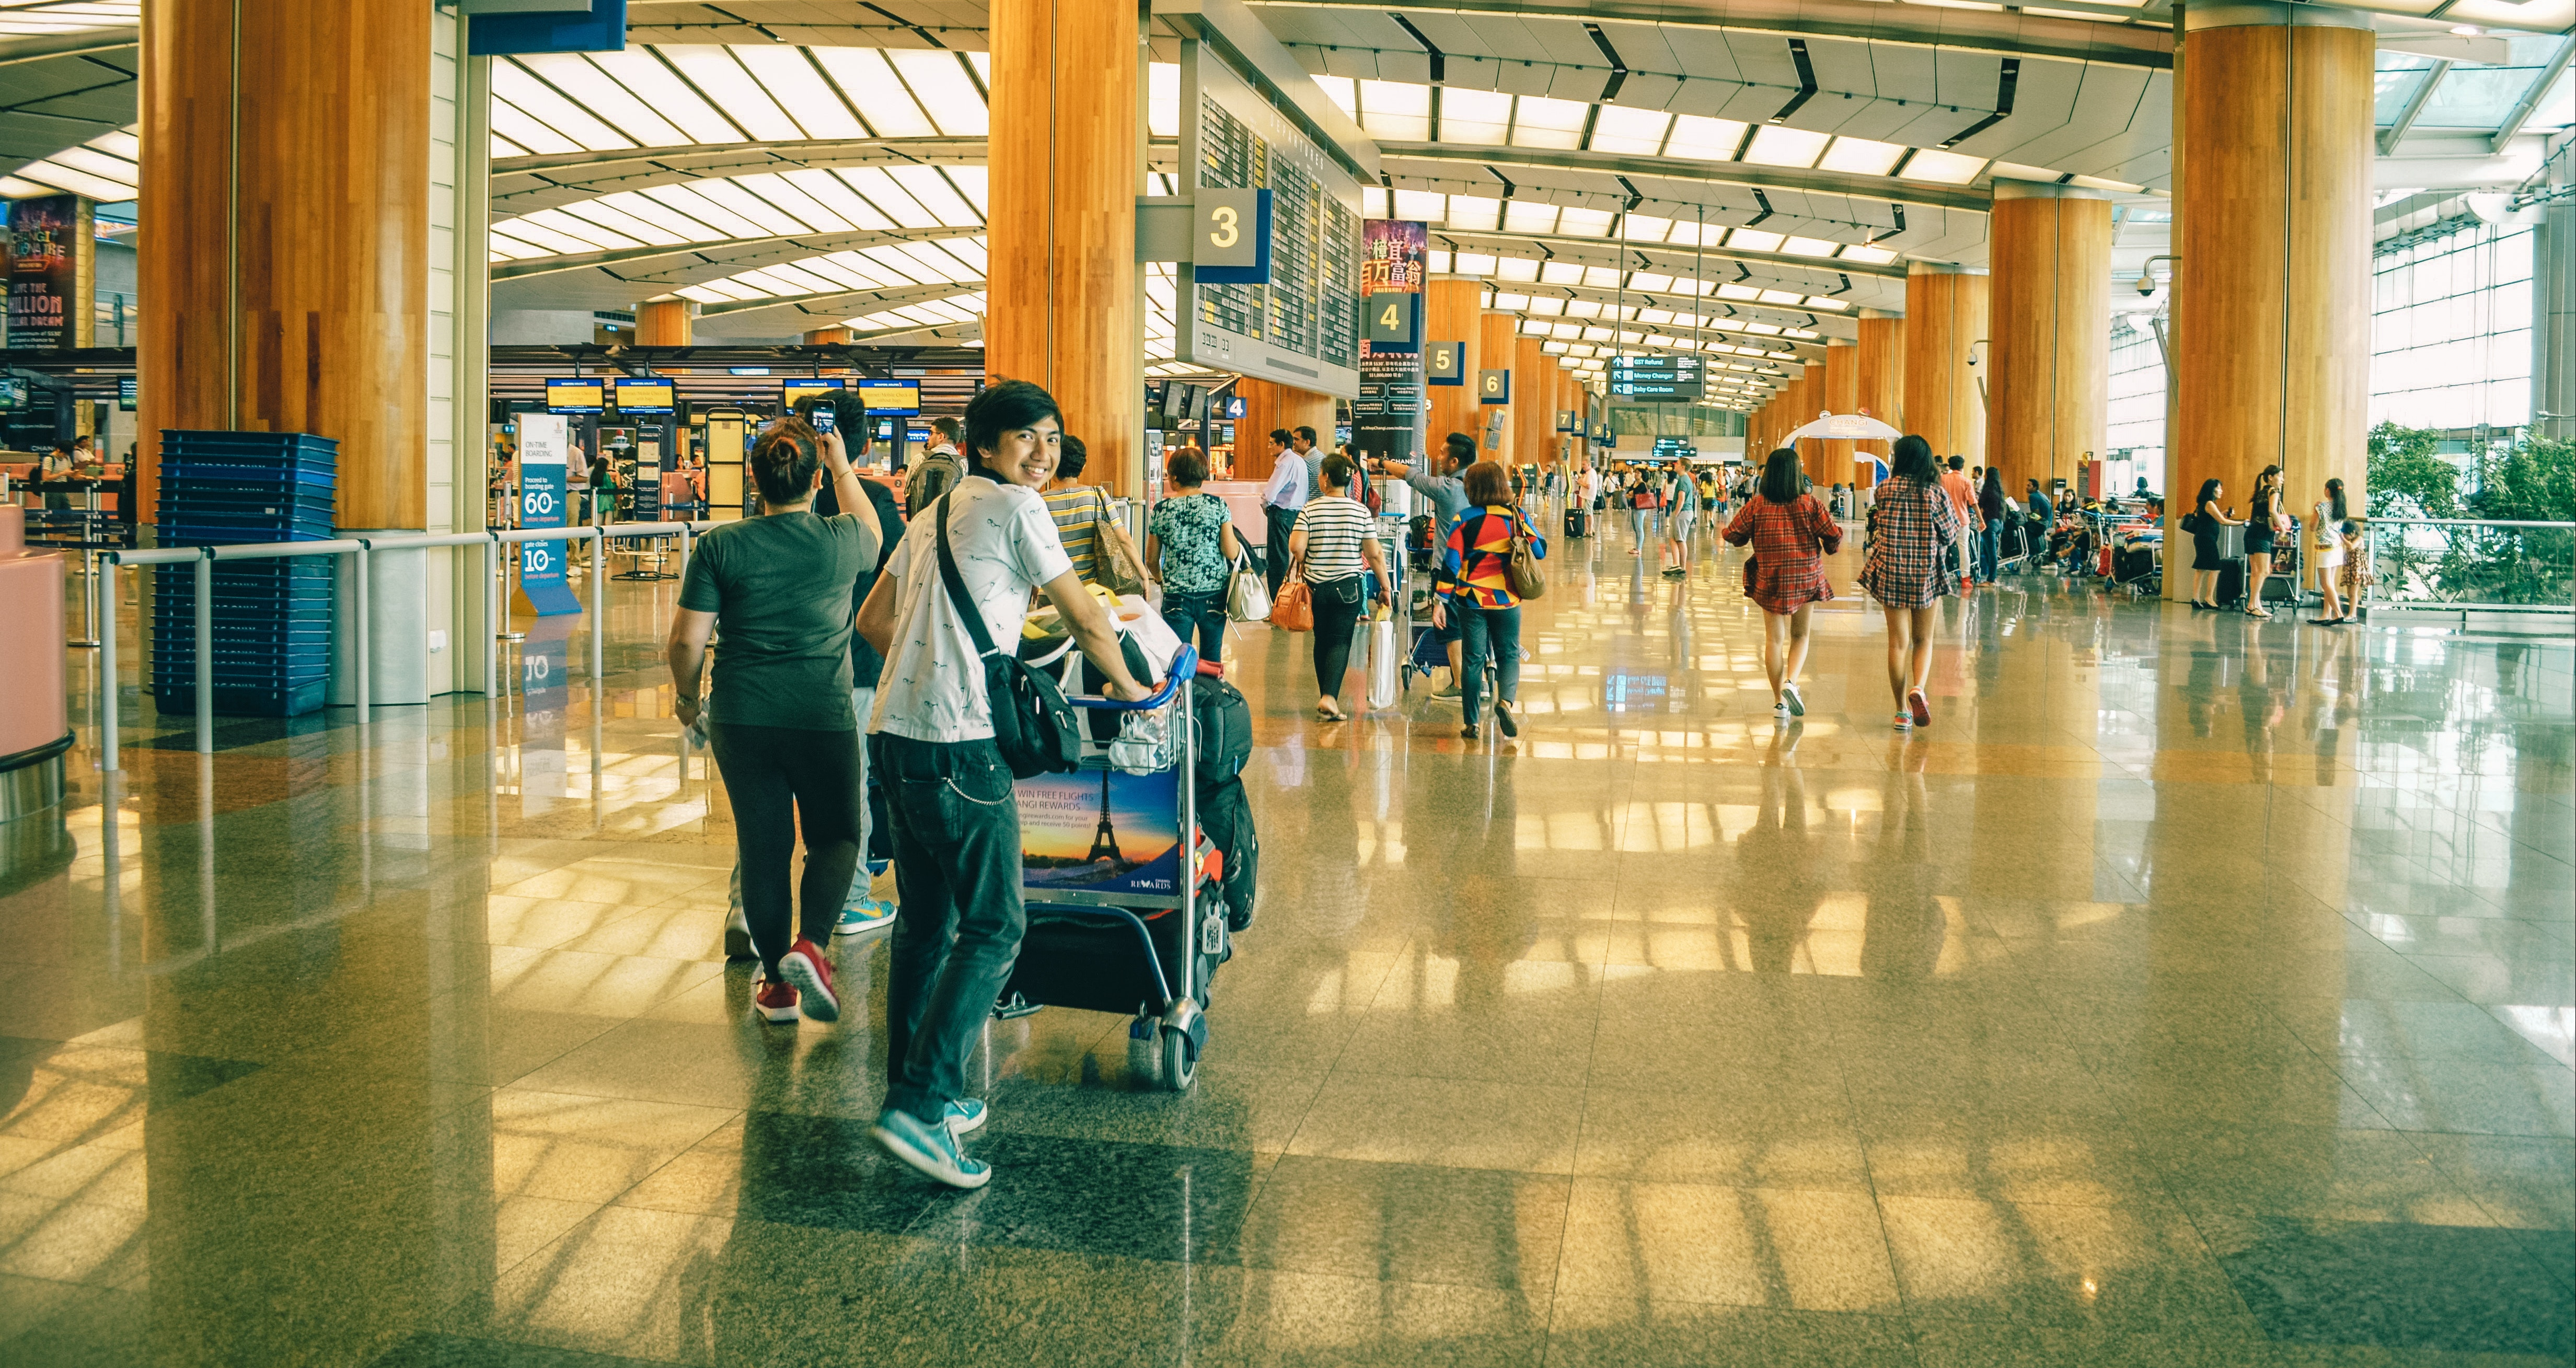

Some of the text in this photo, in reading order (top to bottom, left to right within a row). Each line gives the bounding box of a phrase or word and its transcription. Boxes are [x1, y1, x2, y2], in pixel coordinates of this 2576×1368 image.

[1270, 113, 1323, 170] DEPARTURES
[1210, 206, 1239, 247] 3
[1372, 238, 1404, 260] 樟宜
[1380, 304, 1400, 330] 4
[1436, 350, 1450, 370] 5
[1486, 376, 1498, 392] 6
[1229, 399, 1243, 416] 4
[1561, 414, 1568, 424] 7
[1575, 421, 1581, 430] 8
[1595, 426, 1601, 434] 9
[525, 492, 552, 514] 60
[525, 550, 549, 572] 10
[1037, 791, 1057, 799] FREE
[1059, 792, 1094, 801] FLIGHTS
[1017, 800, 1081, 810] ANGI REWARDS
[1131, 879, 1171, 889] REWARDS
